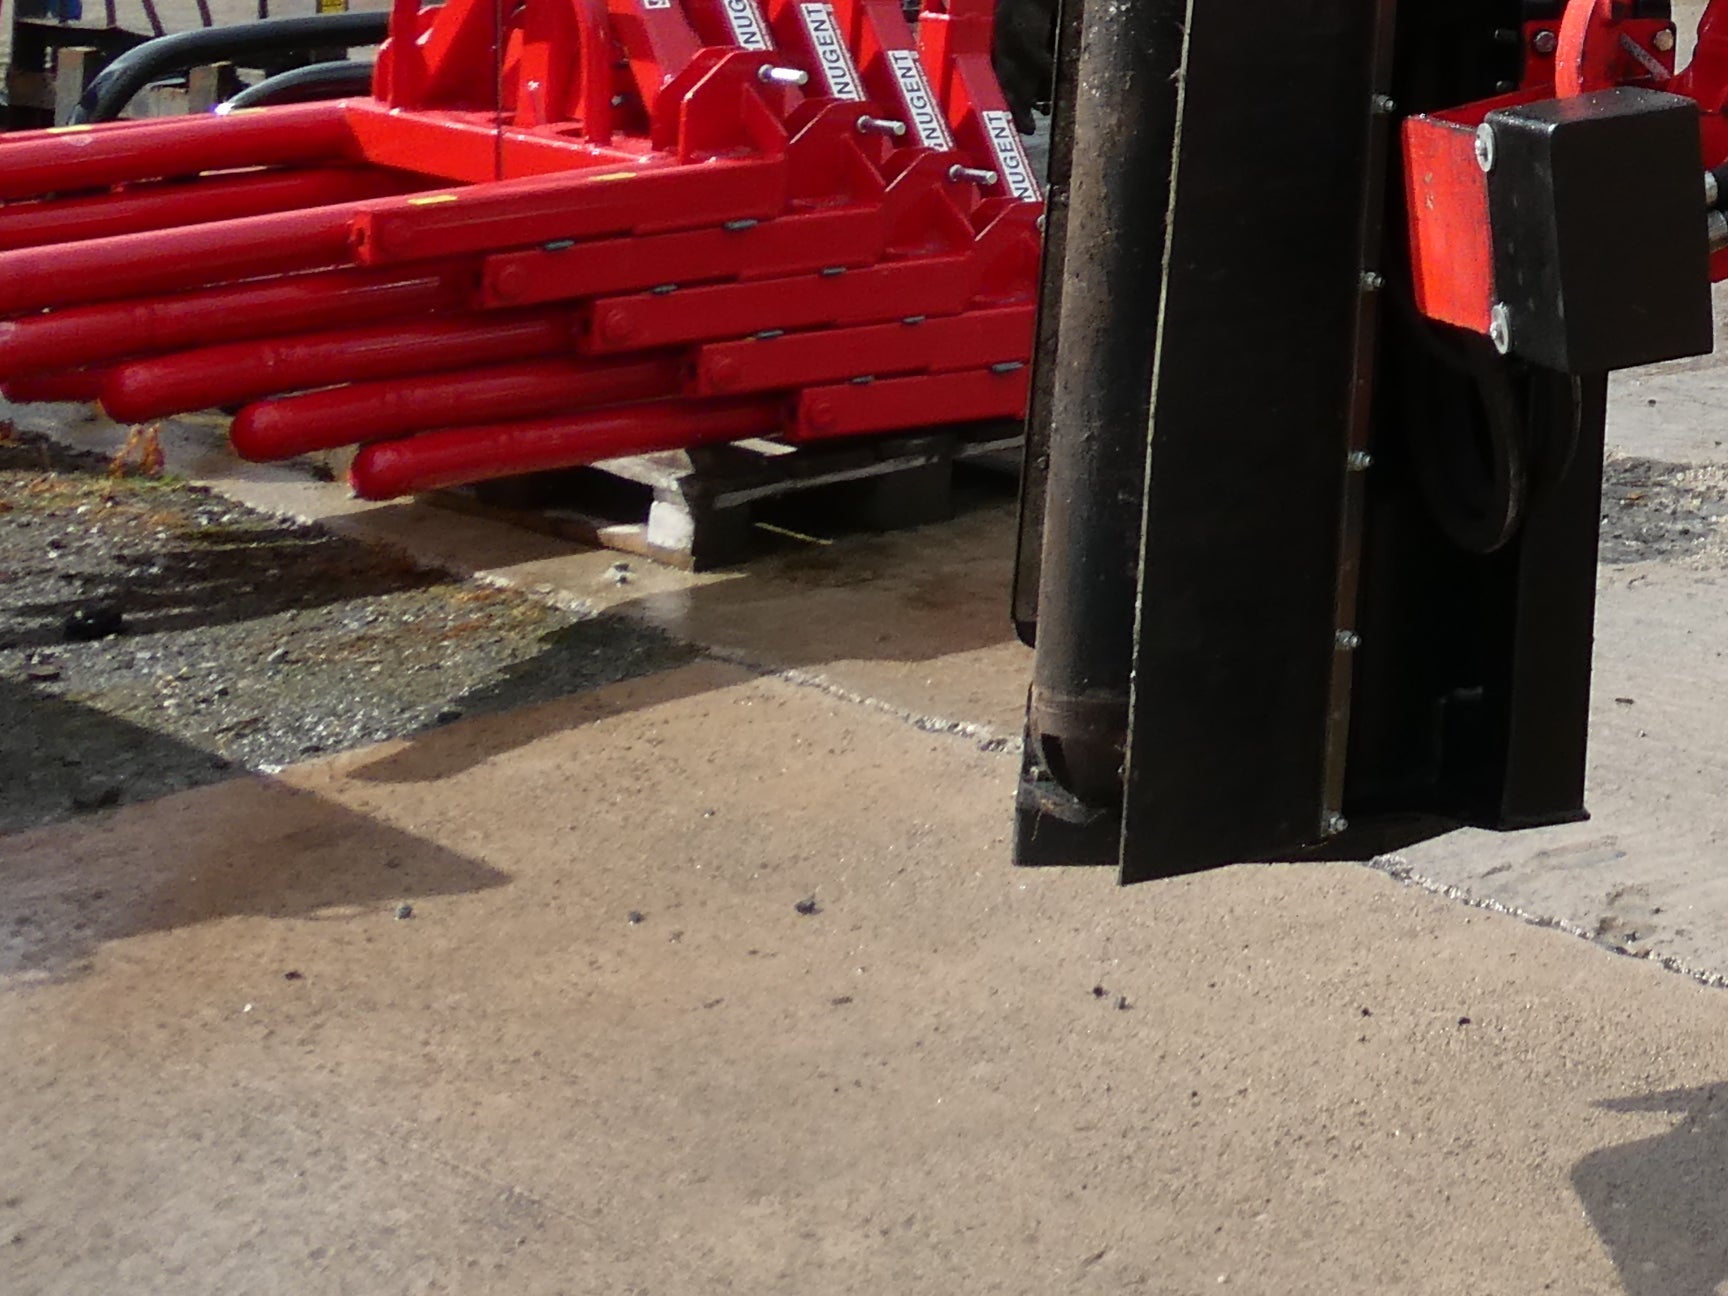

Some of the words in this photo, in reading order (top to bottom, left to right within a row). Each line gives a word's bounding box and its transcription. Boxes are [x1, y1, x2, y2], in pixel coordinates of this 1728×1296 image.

[804, 5, 853, 95] NUGENT
[892, 54, 941, 140] NUGENT
[986, 113, 1033, 201] NUGENT
